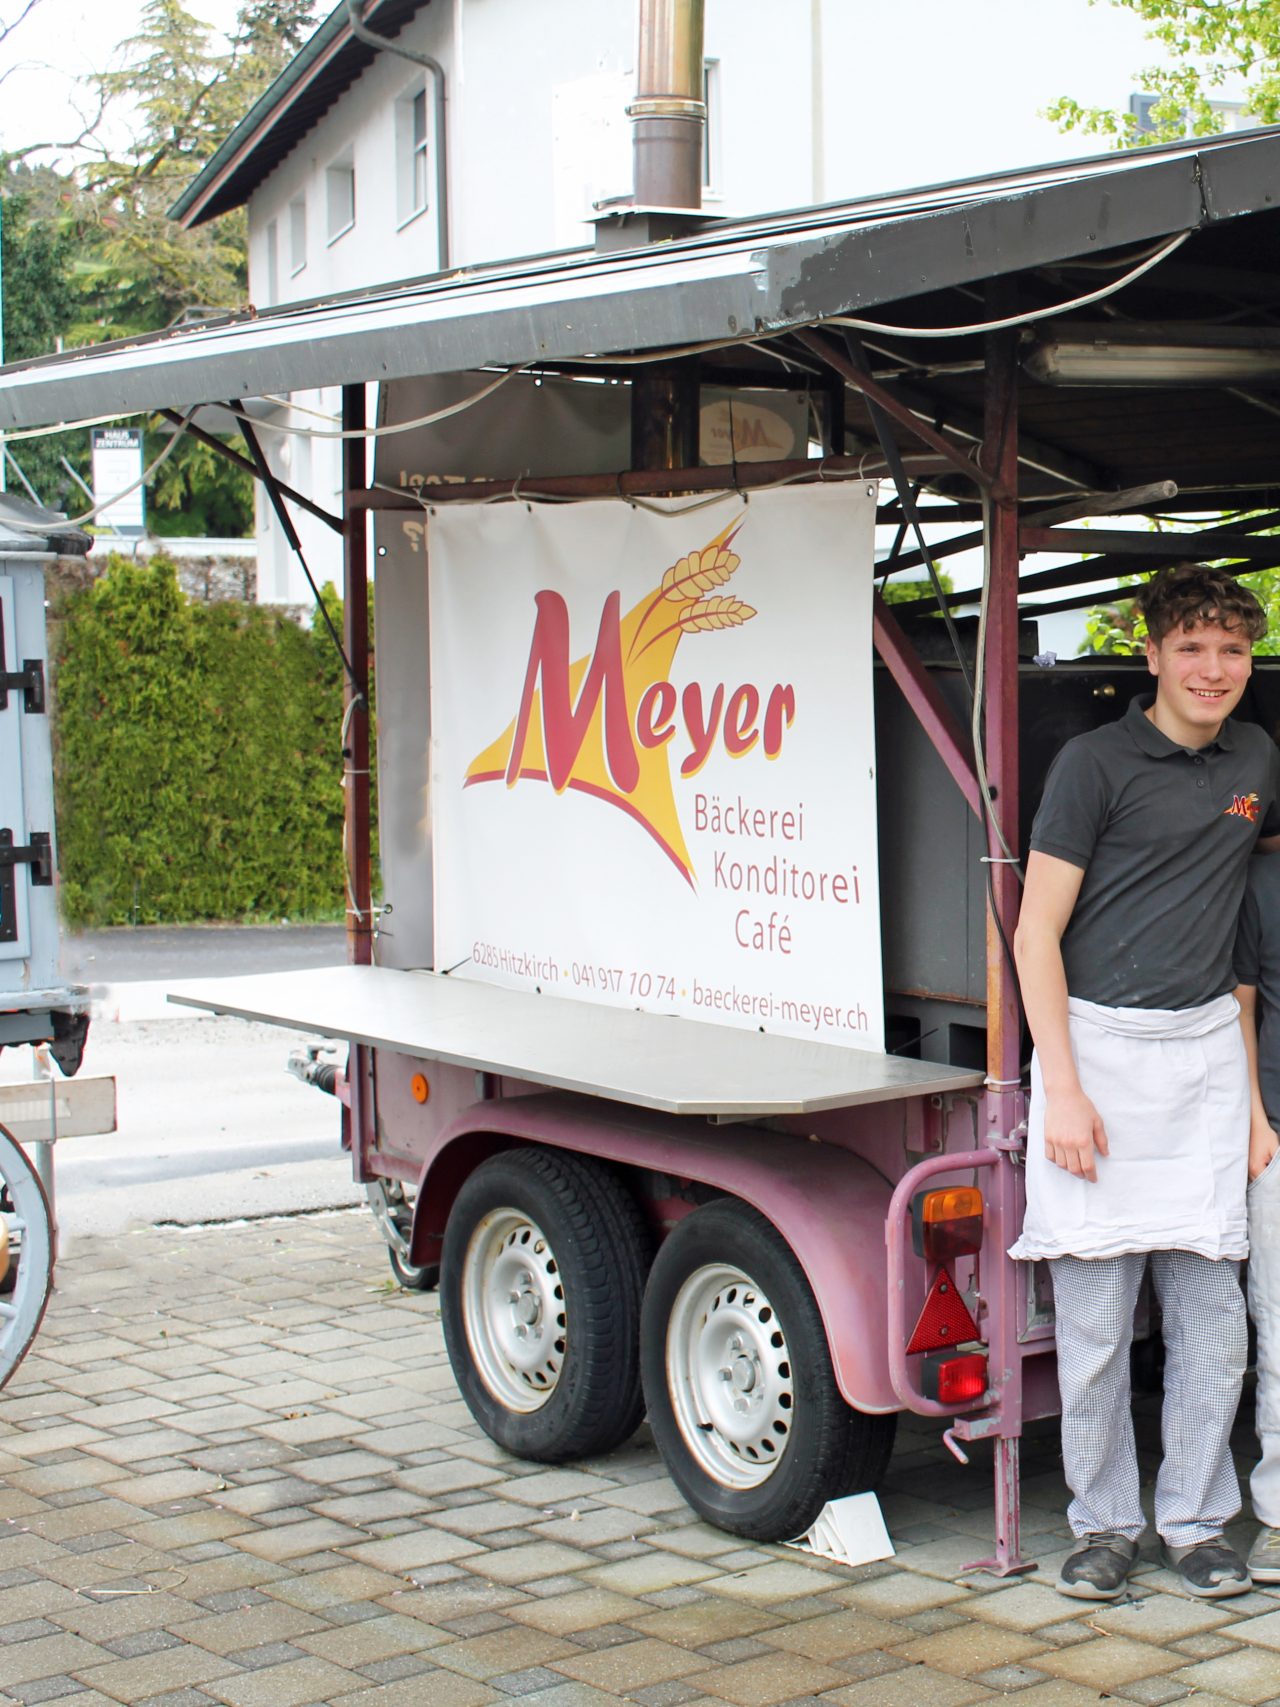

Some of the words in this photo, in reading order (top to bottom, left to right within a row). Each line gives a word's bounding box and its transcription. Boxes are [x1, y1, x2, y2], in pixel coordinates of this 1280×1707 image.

[96, 438, 139, 449] ZENTRUM
[506, 589, 796, 796] Meyer
[695, 793, 803, 841] Bäckerei
[714, 850, 860, 904] Konditorei
[735, 909, 792, 954] Café
[472, 941, 499, 969] 6285
[499, 947, 559, 982] Hitzkirch
[571, 962, 596, 988] 041
[598, 967, 623, 993] 917
[629, 972, 652, 997] 10
[656, 975, 676, 1001] 74
[692, 978, 869, 1032] baeckerei-meyer.ch
